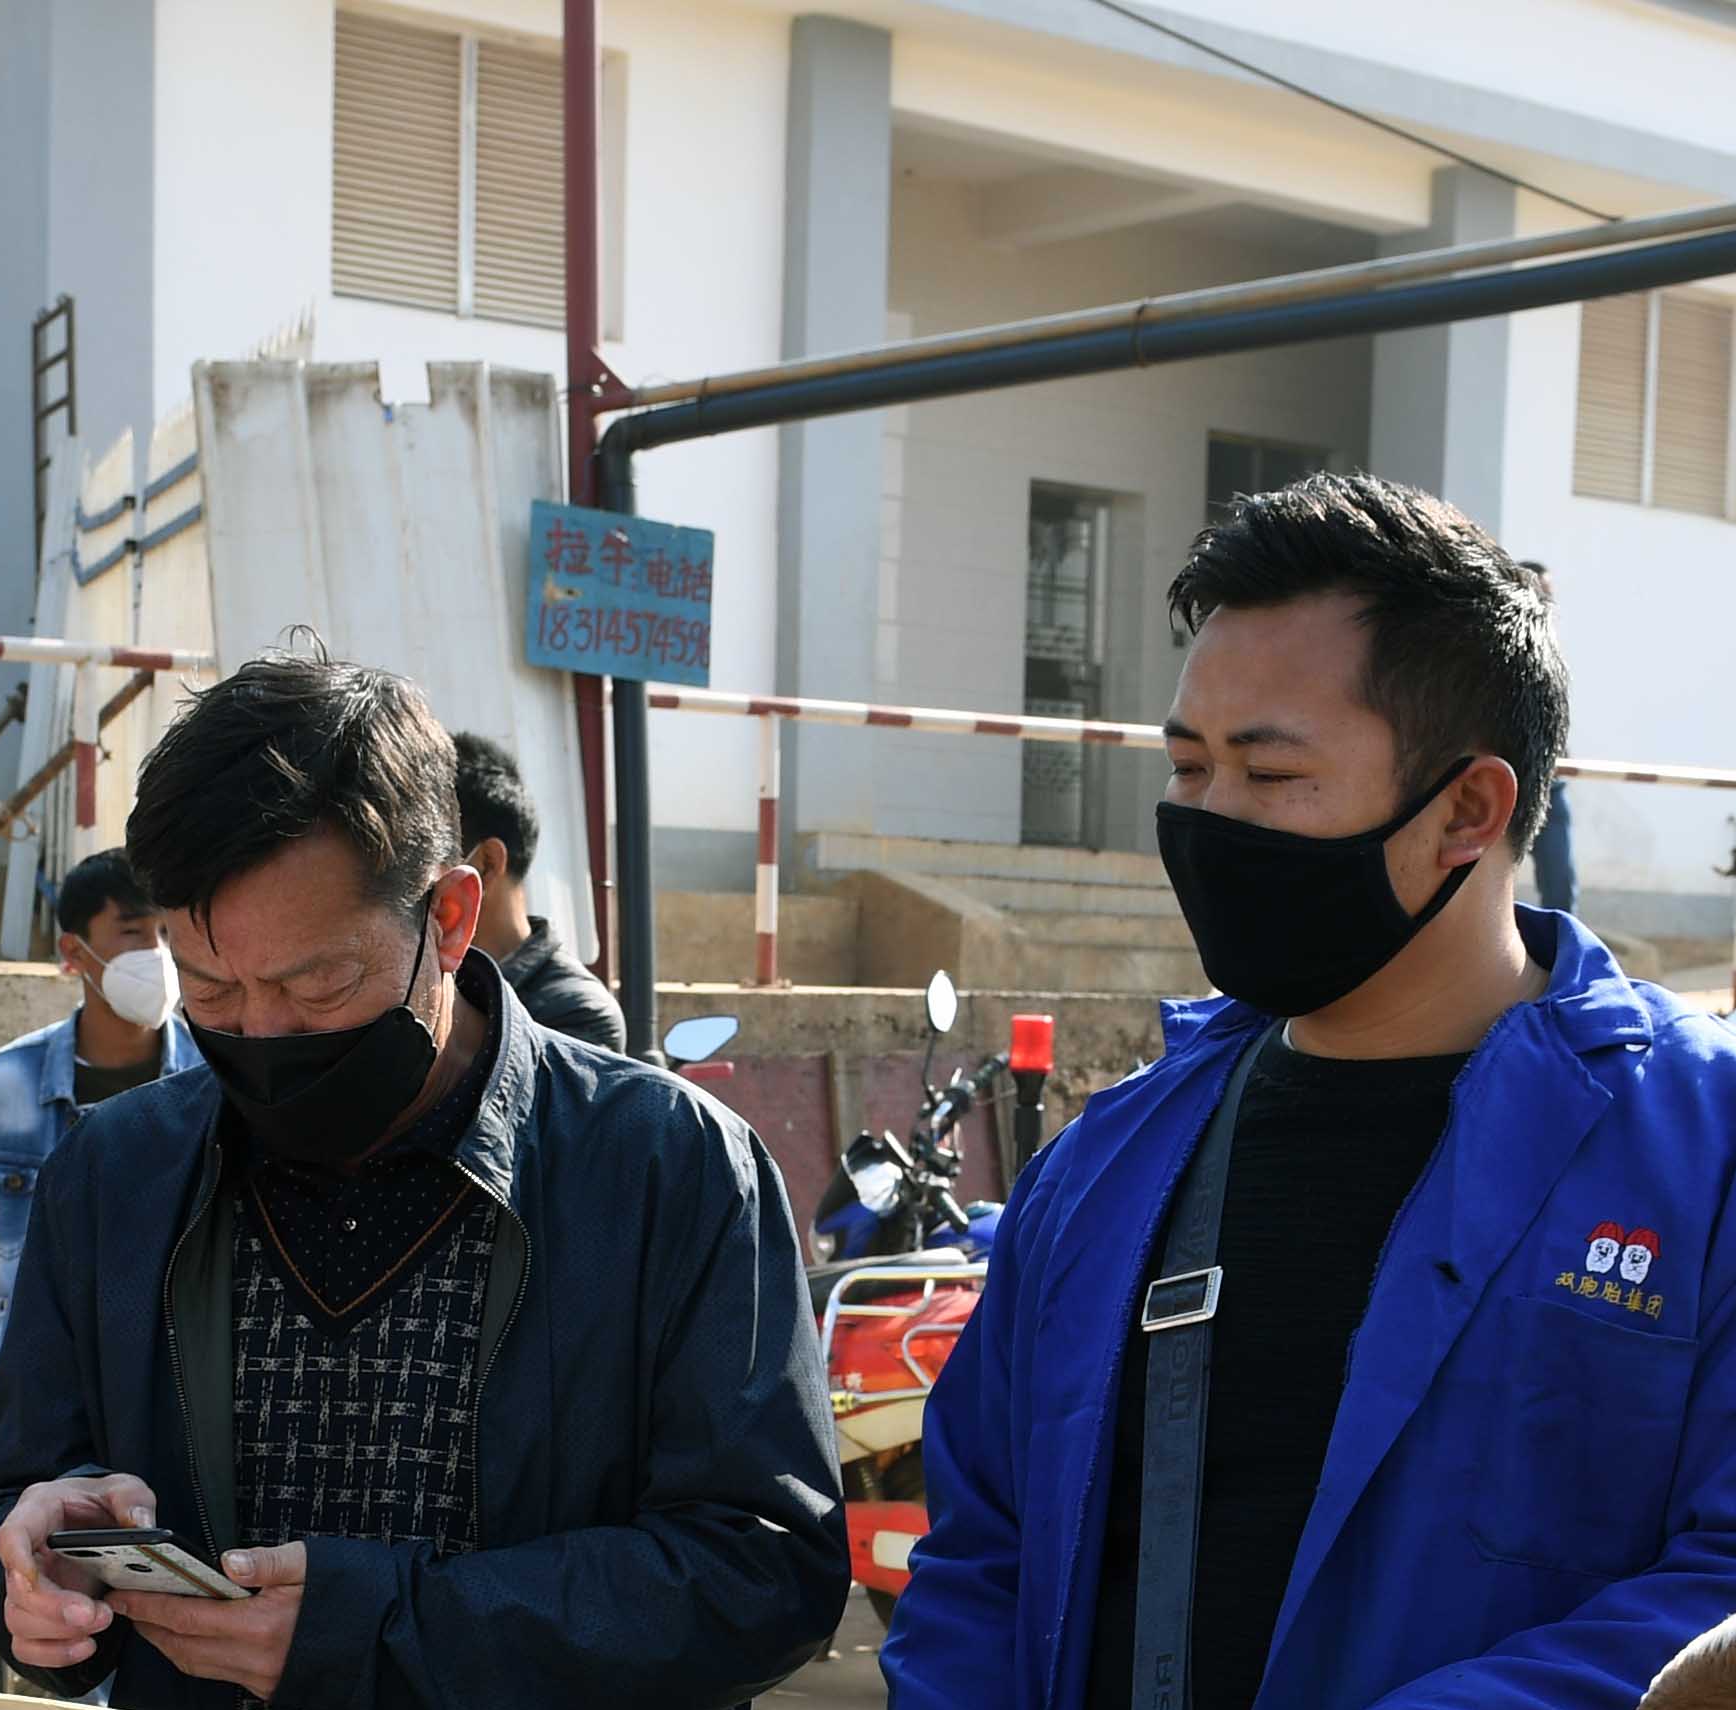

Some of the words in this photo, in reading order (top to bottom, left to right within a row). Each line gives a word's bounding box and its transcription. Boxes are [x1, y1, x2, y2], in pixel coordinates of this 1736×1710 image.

[1555, 1271, 1664, 1320] 双胞胎集团
